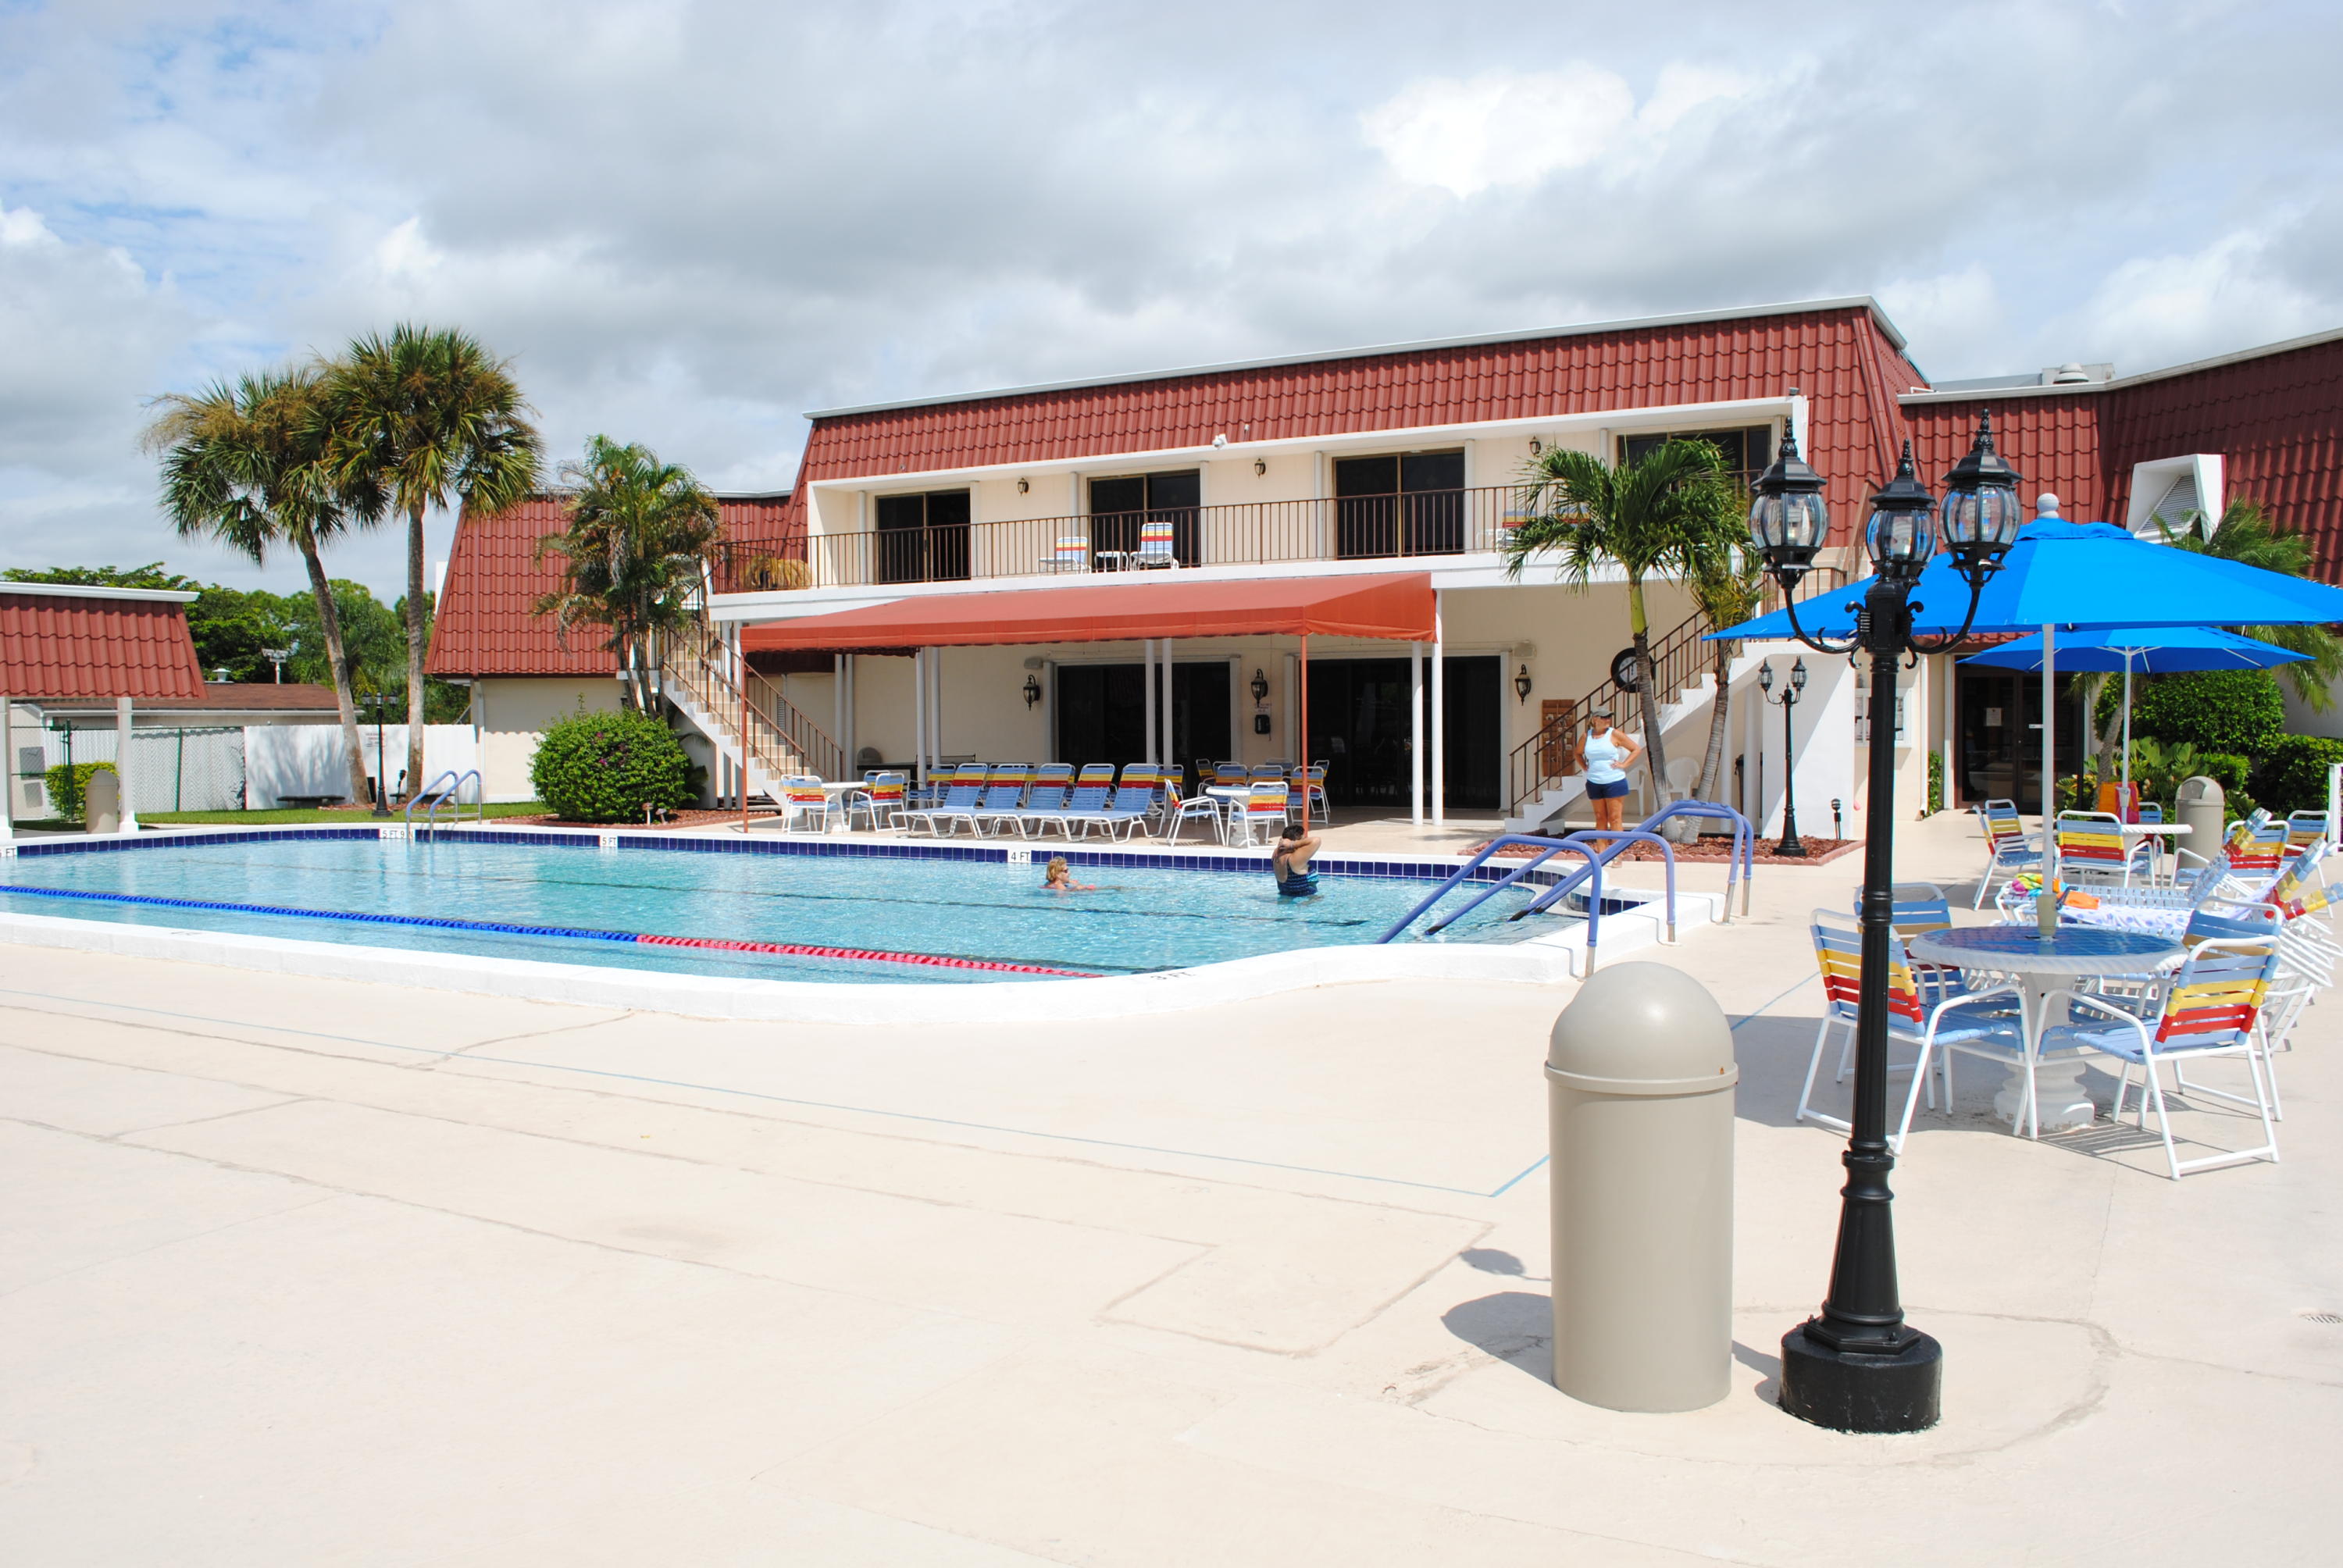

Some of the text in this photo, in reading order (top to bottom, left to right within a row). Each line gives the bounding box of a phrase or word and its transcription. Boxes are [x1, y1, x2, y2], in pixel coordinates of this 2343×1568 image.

[383, 829, 387, 838] 5
[602, 836, 607, 845] 5
[1011, 851, 1016, 861] 4
